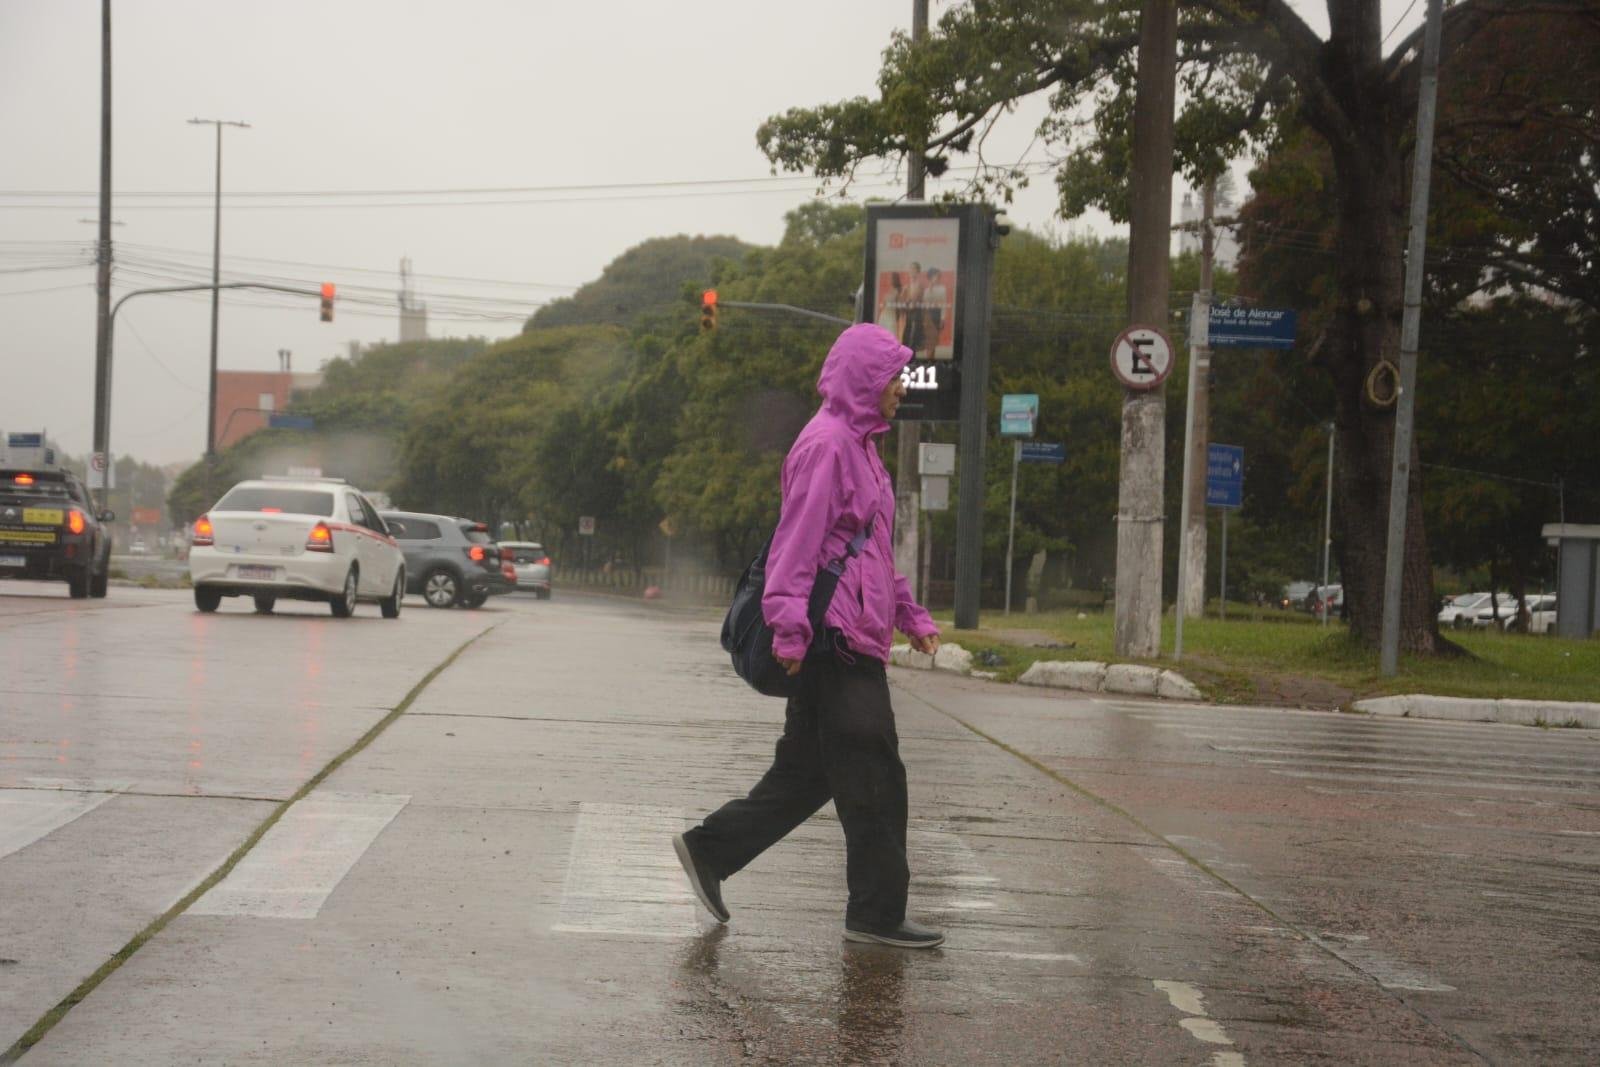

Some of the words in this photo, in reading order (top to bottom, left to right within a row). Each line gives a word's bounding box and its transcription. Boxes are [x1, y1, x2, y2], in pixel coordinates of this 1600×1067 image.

[1210, 306, 1231, 317] José
[1233, 307, 1246, 318] de
[1248, 308, 1284, 319] Alencar
[1131, 338, 1154, 374] E
